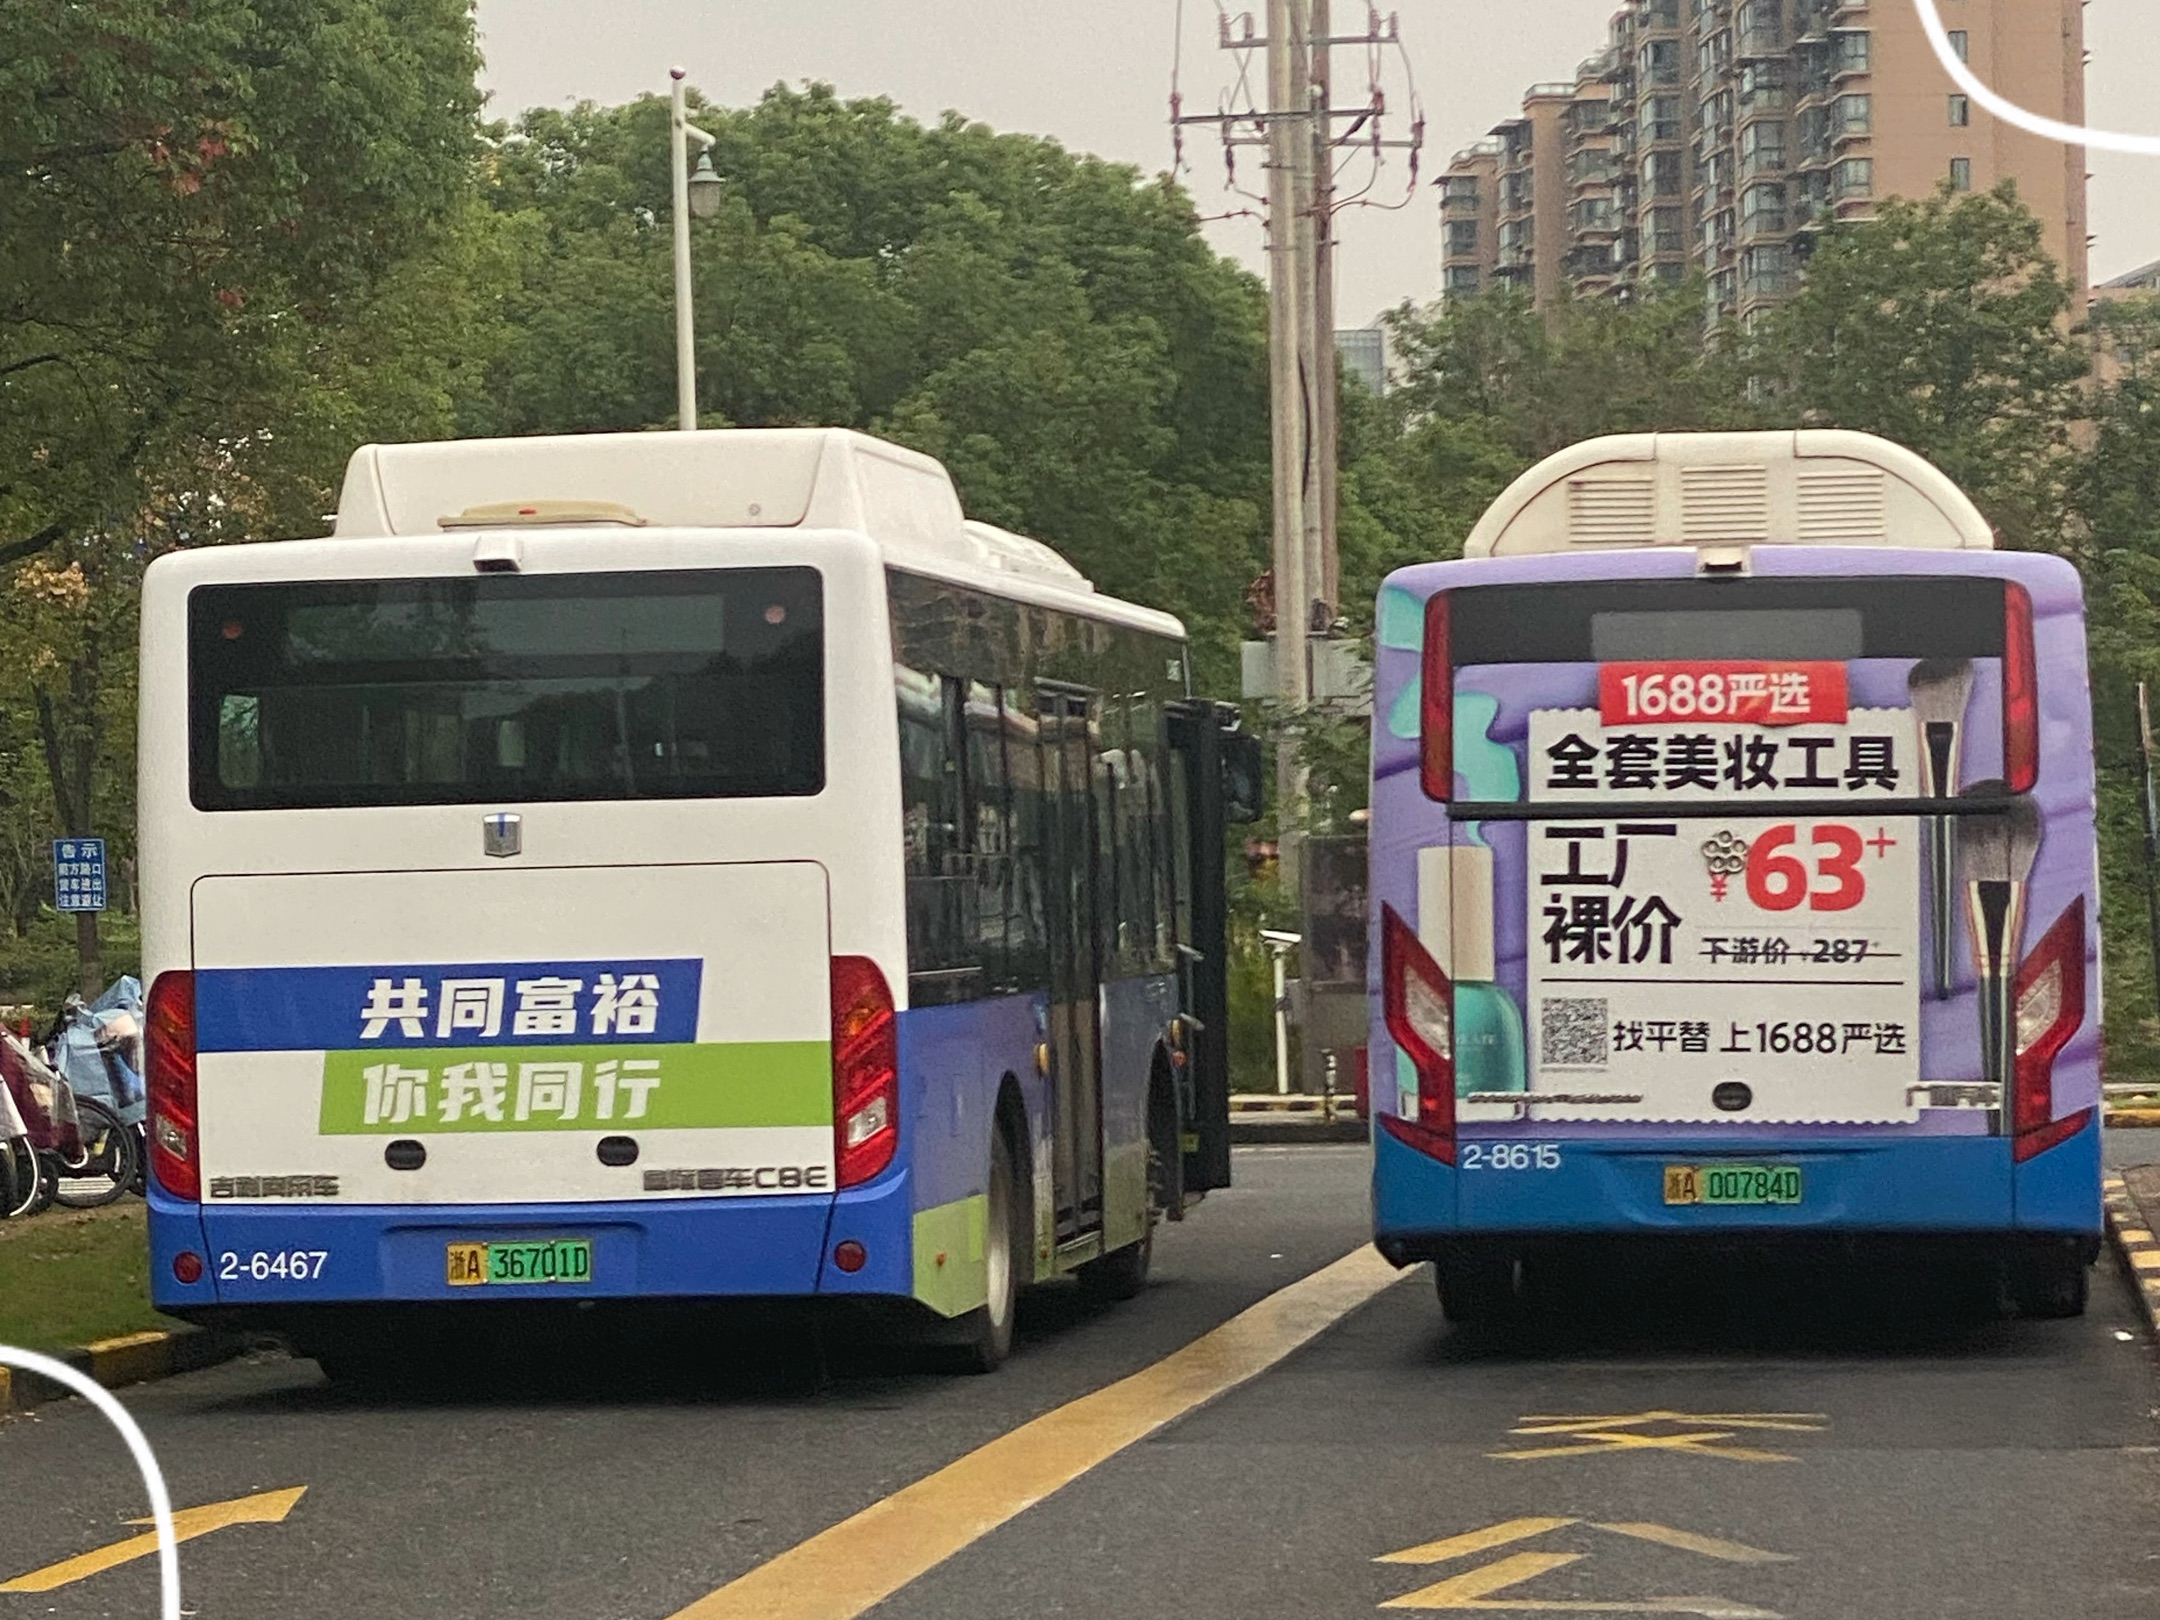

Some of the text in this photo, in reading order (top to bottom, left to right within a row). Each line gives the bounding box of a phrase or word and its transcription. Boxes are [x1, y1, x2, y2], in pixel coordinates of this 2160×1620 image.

[1622, 673, 1810, 715] 1688严选
[1546, 733, 1899, 791] 全套美妆工具
[1541, 824, 1677, 888] 工厂
[1543, 893, 1682, 963] 裸价
[1702, 937, 1789, 964] 下游价
[359, 973, 660, 1039] 共同富裕
[1613, 1021, 1905, 1054] 找平替 上1688严选
[361, 1058, 661, 1124] 你我同行
[1463, 1144, 1562, 1171] 2-8615
[218, 1250, 329, 1281] 2-6467
